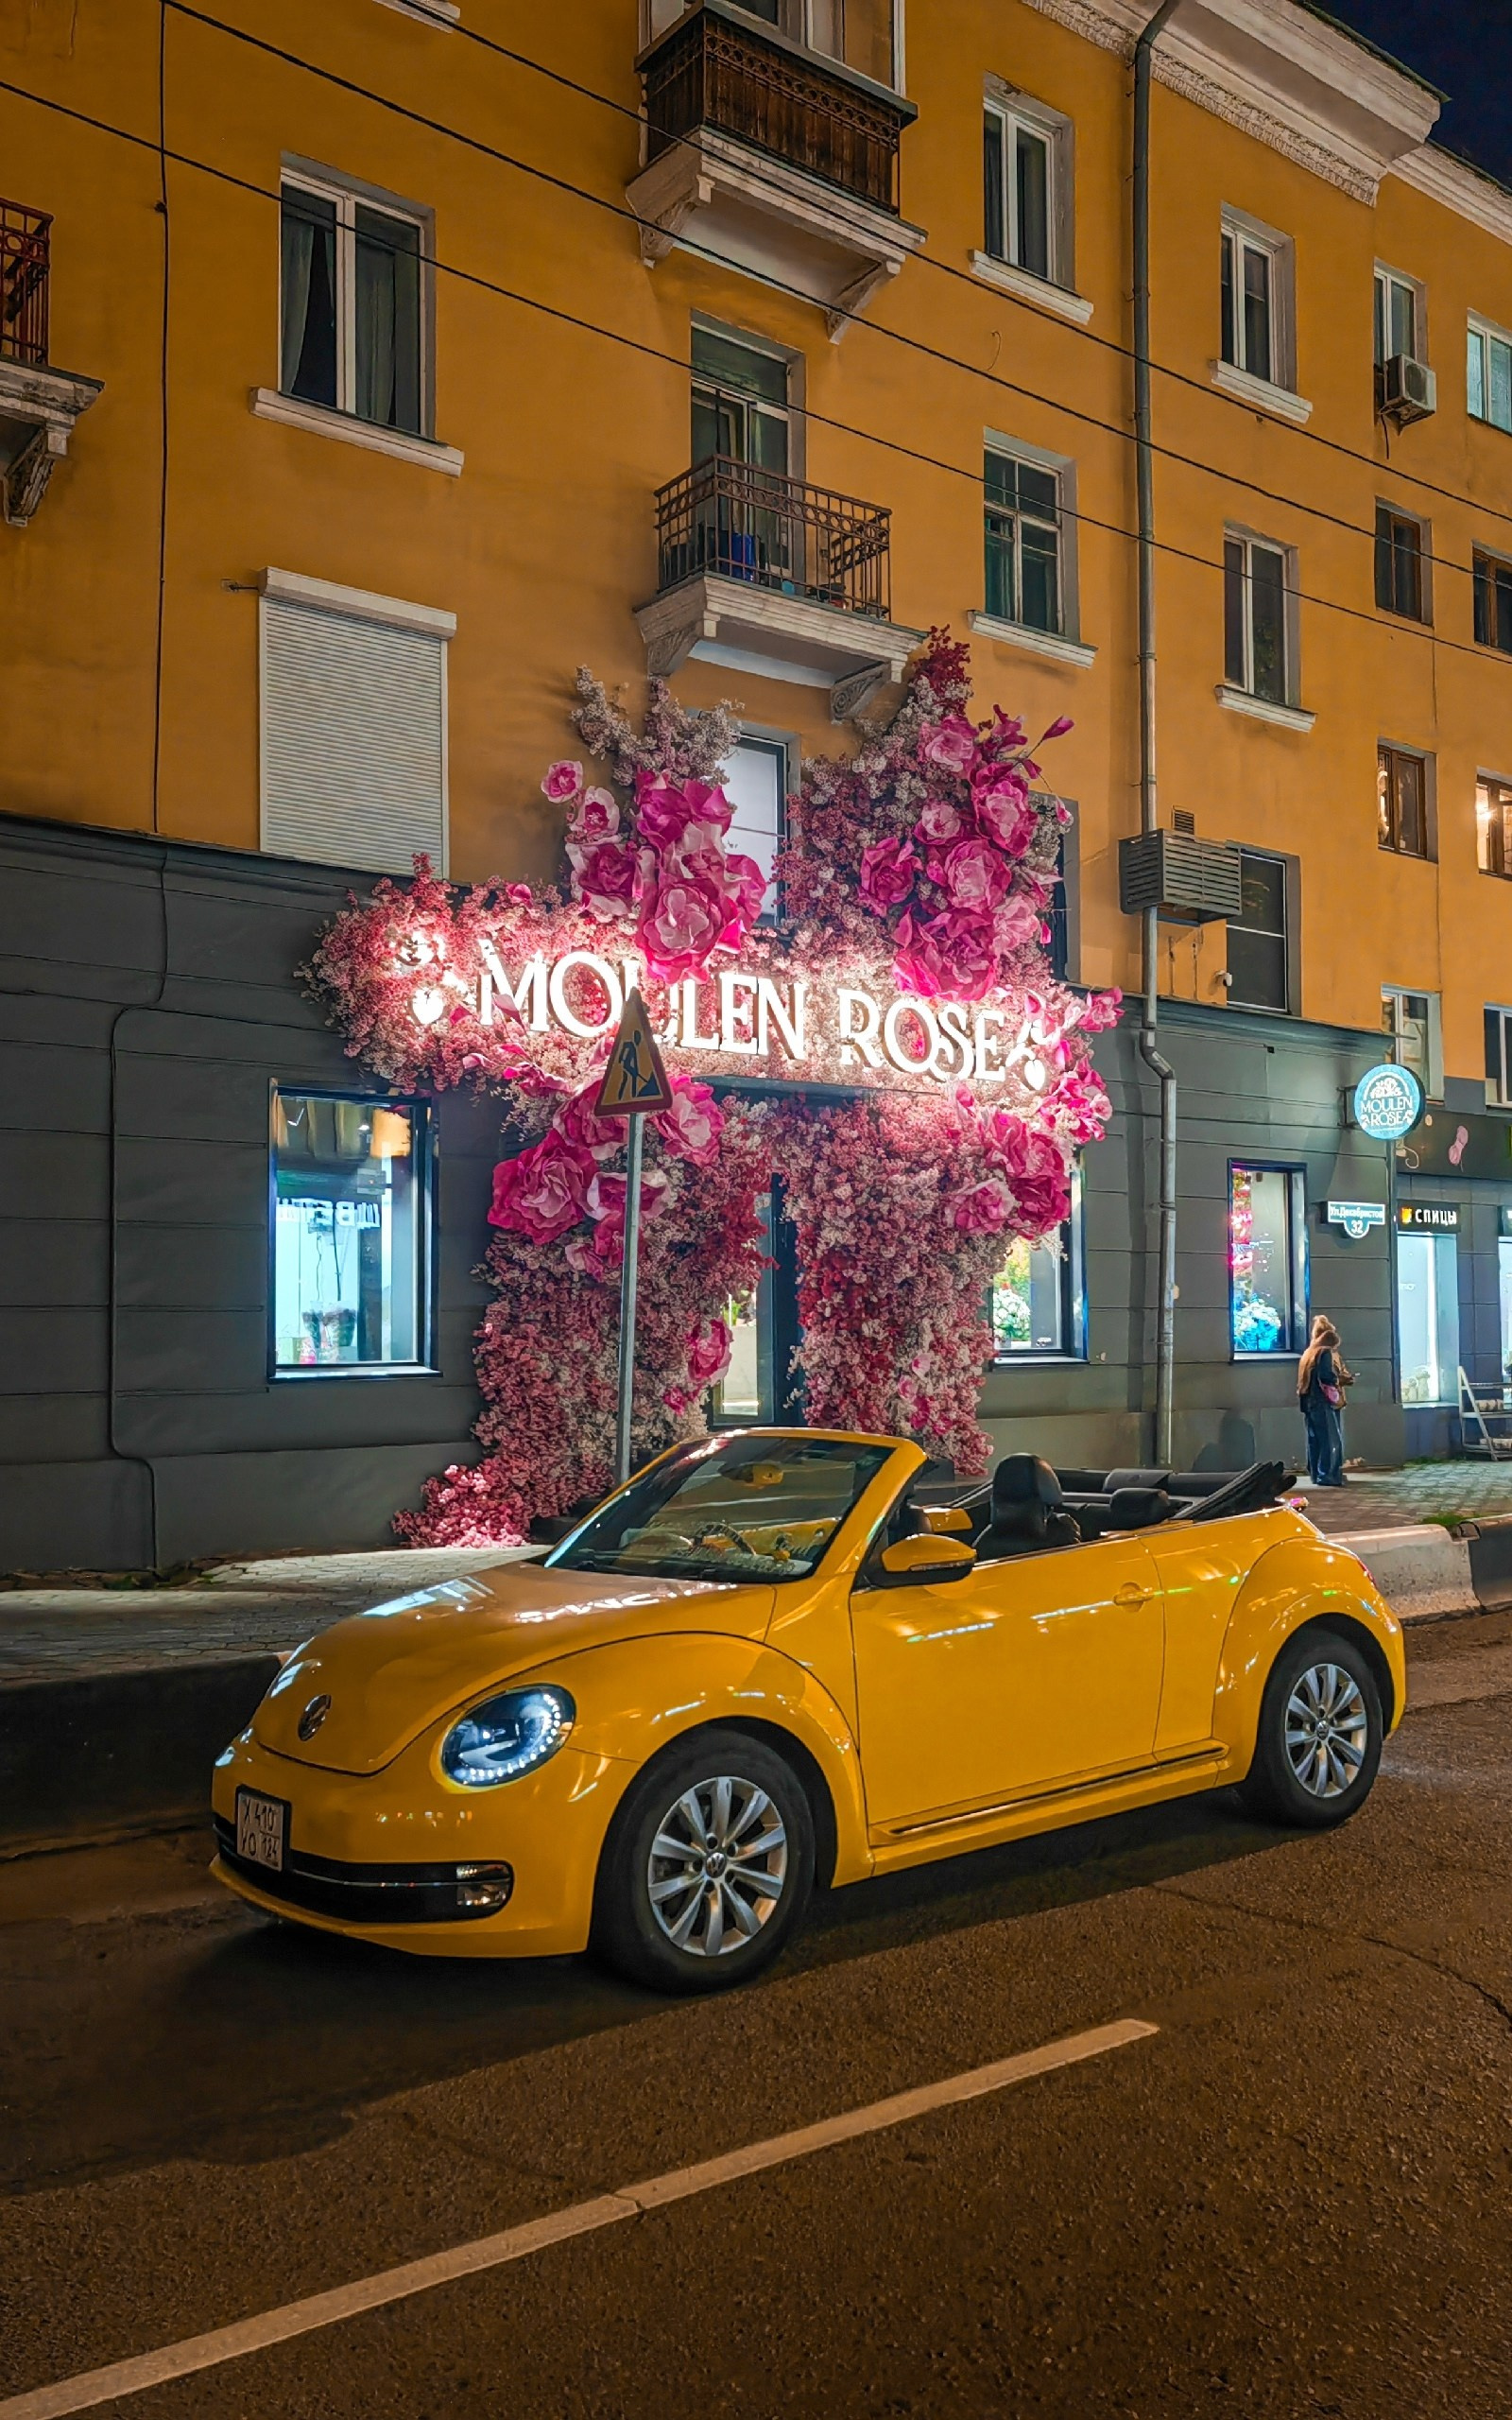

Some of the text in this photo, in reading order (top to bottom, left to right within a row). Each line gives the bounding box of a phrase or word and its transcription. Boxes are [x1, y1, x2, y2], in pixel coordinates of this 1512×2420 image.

[837, 988, 1006, 1083] ROSE
[1361, 1097, 1414, 1114] MOULEN
[1370, 1111, 1404, 1127] ROSE
[1415, 1208, 1457, 1226] СПИЦЫ
[1350, 1219, 1364, 1235] 32
